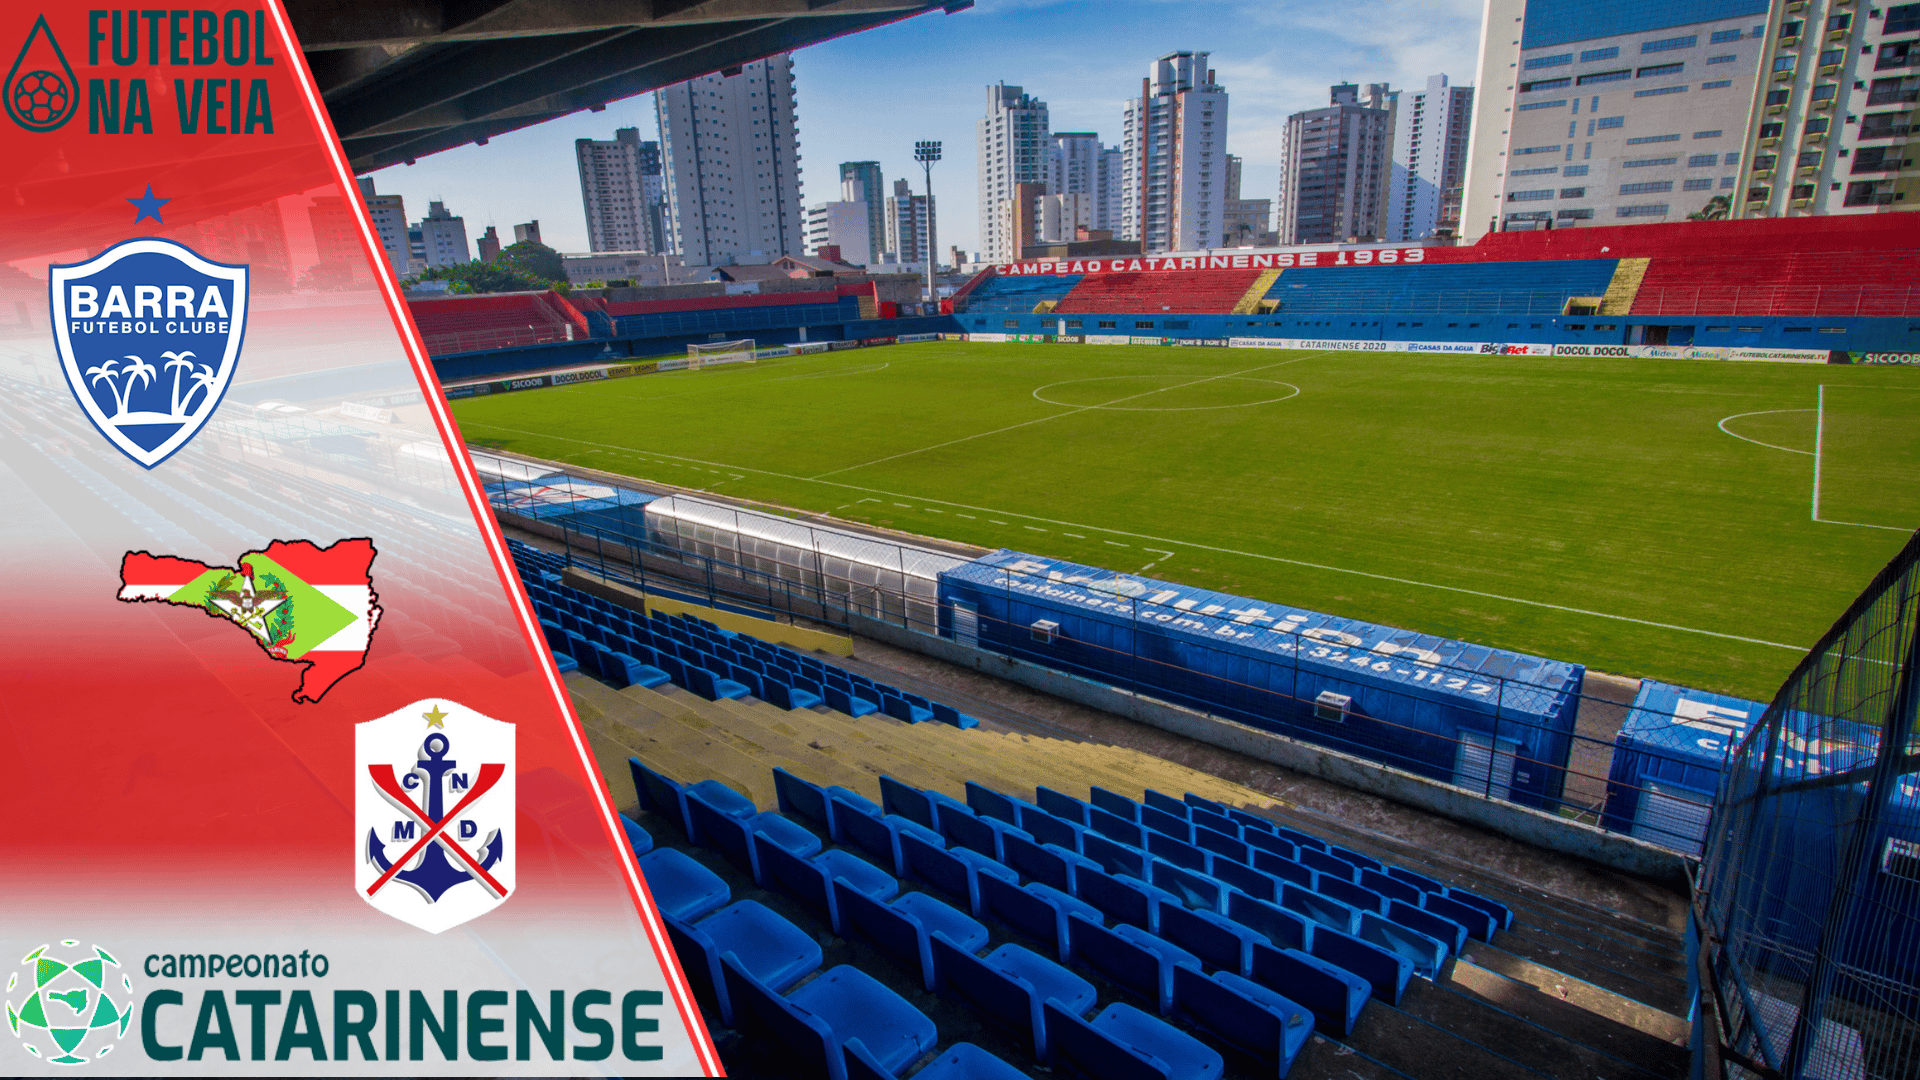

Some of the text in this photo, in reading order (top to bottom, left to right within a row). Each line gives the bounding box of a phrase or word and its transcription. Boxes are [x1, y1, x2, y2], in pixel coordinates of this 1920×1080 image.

[1111, 253, 1317, 270] CATARINENSE
[1334, 249, 1424, 265] 1963
[1300, 341, 1386, 352] CATARINENSE 2020
[1557, 346, 1591, 355] DOCOL
[1594, 347, 1630, 357] DOCOL
[511, 378, 543, 389] SICOOB
